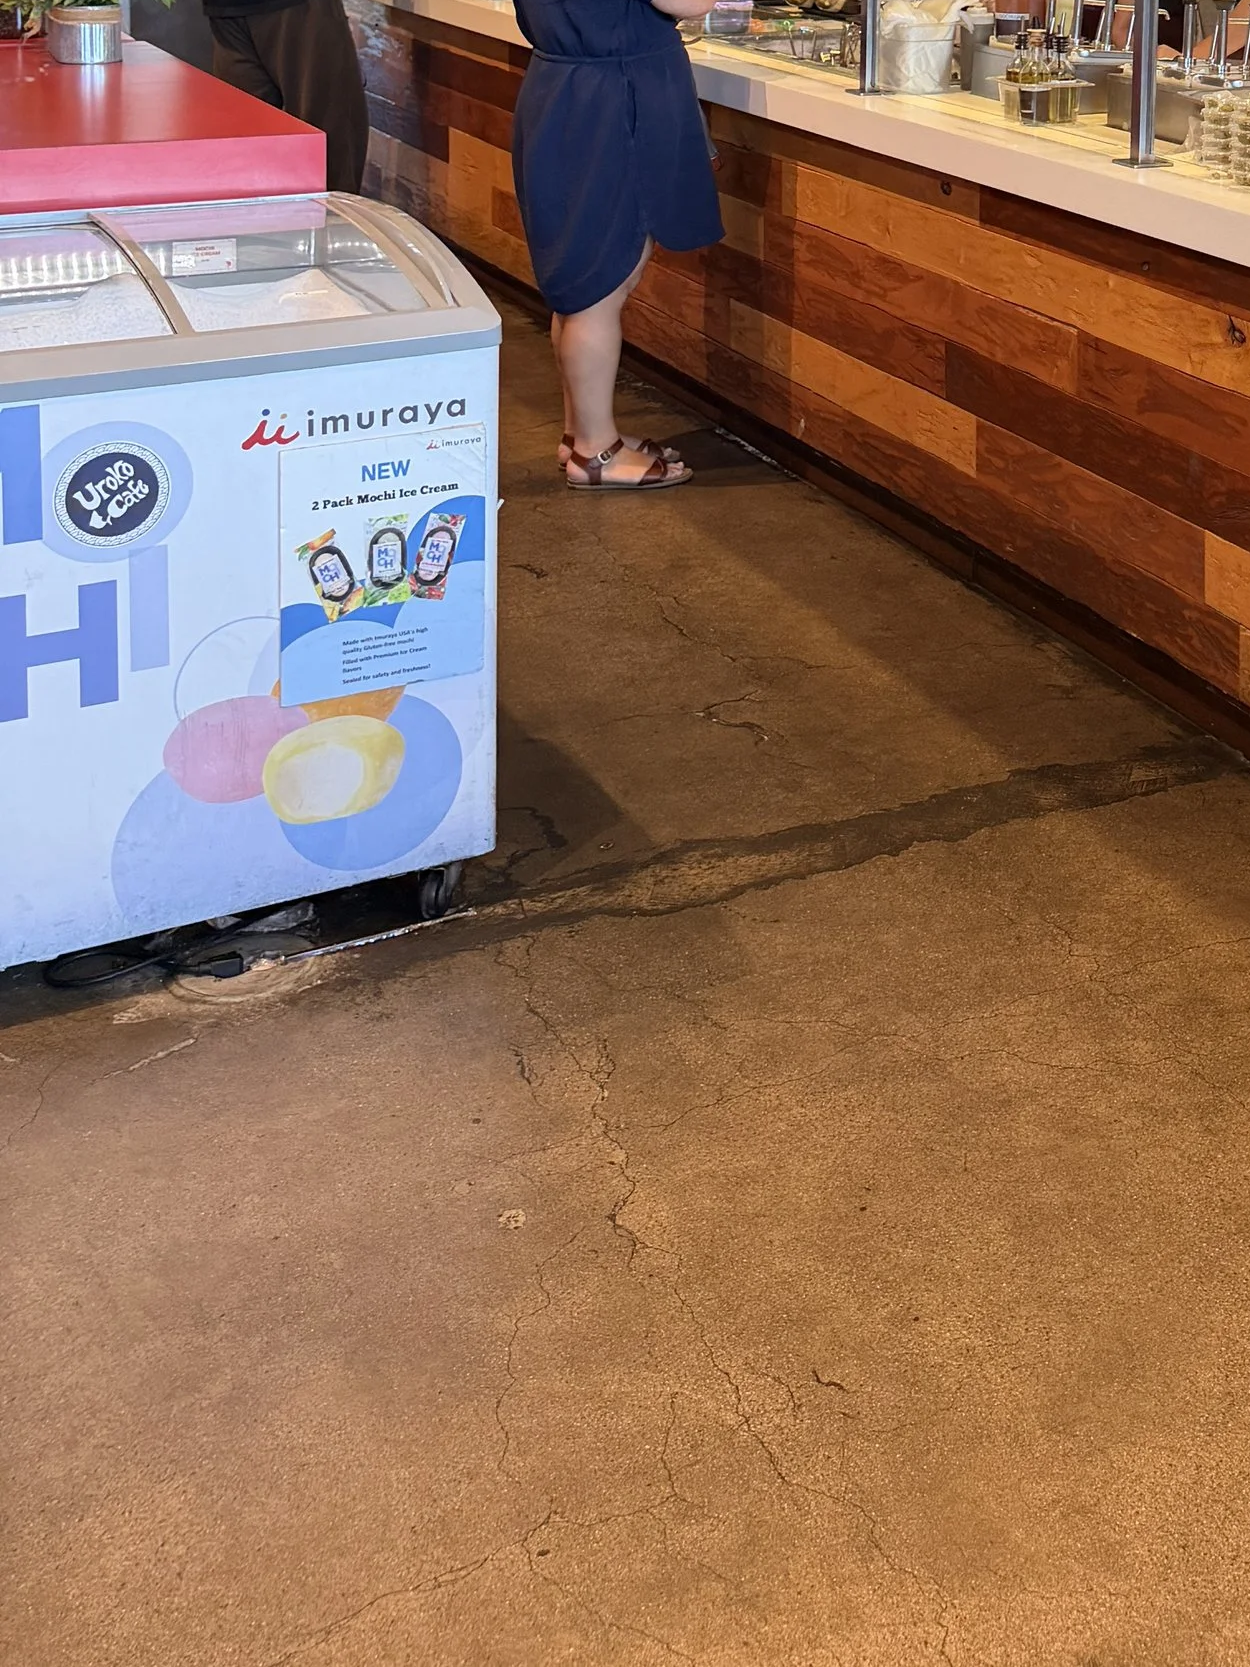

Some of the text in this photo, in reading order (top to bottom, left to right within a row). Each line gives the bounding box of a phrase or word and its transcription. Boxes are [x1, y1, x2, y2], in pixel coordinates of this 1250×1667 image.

[307, 398, 466, 437] imuraya
[442, 436, 481, 447] imuraya
[361, 459, 411, 482] NEW
[72, 460, 135, 511] Uroko
[312, 483, 459, 511] 2 Pack Mochi Ice Cream
[364, 642, 395, 650] Gluten-free
[373, 651, 398, 659] Premium
[403, 664, 431, 673] freshness!
